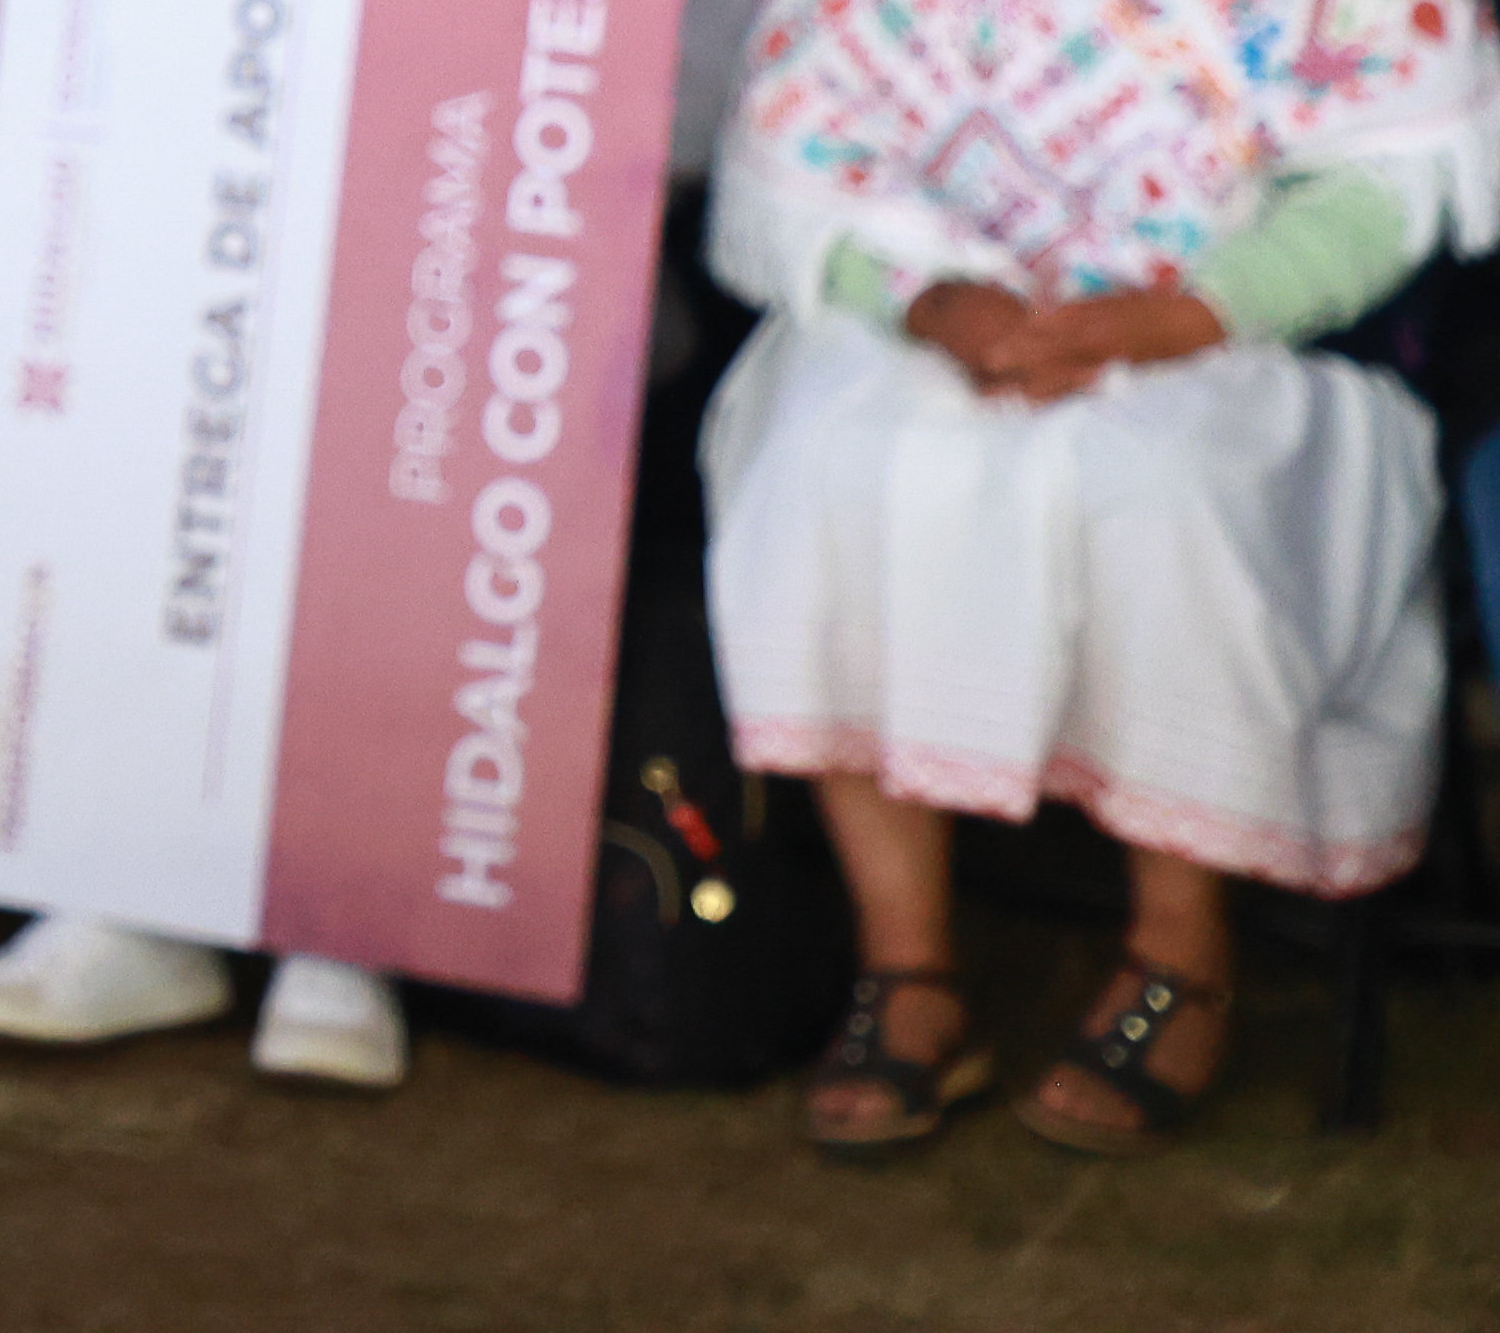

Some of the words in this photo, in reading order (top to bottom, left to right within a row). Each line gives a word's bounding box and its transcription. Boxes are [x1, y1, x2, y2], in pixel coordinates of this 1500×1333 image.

[204, 169, 268, 269] DE
[388, 89, 497, 505] PROGRAMA
[482, 252, 577, 465] CON
[160, 293, 251, 652] ENTREGA
[434, 476, 554, 911] HIDALGO
